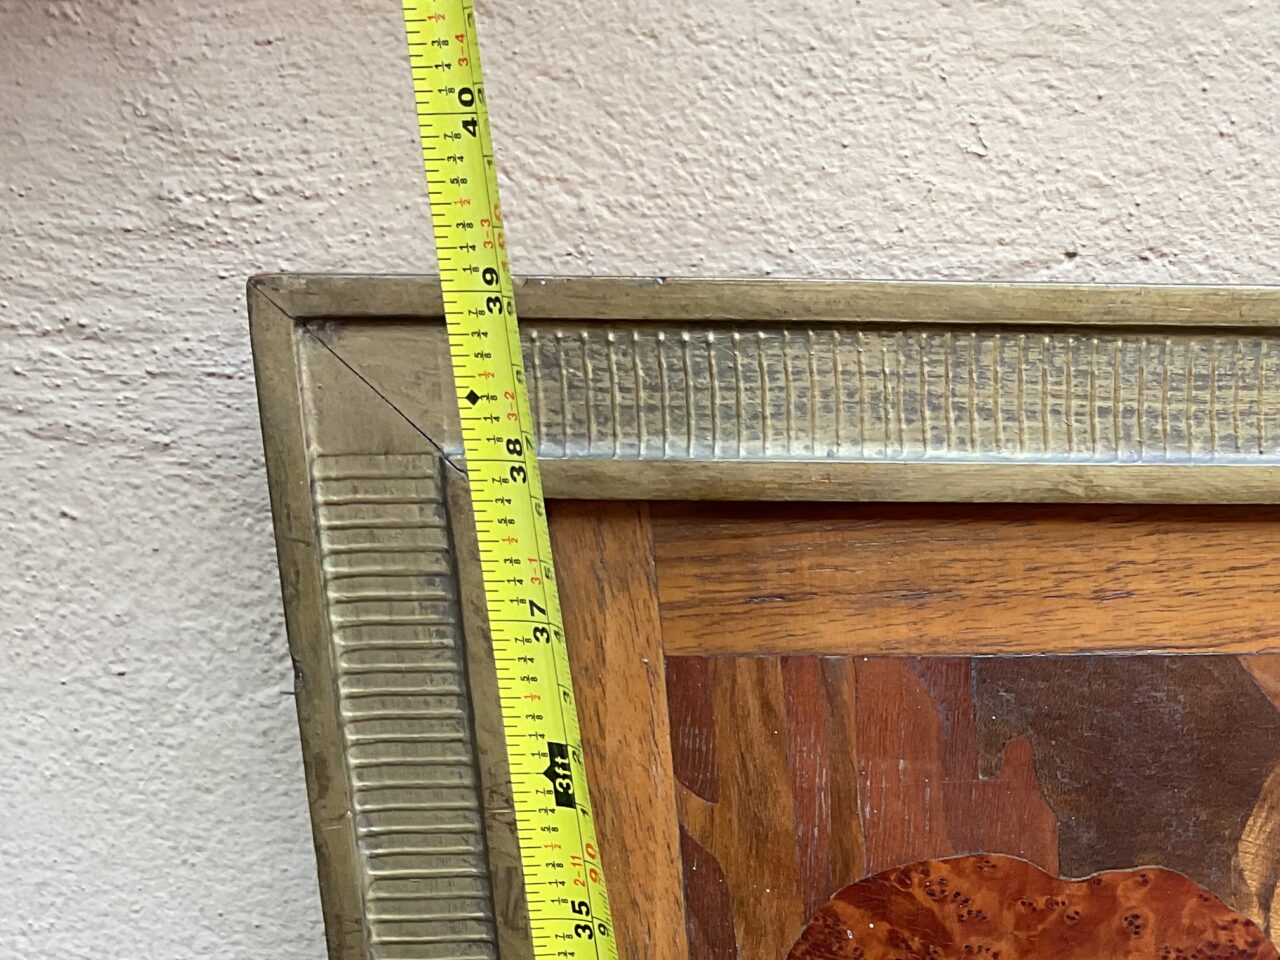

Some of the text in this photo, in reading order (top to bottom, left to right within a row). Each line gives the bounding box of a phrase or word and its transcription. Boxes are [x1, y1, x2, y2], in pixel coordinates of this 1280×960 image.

[458, 87, 478, 137] 40
[482, 268, 502, 314] 39
[506, 438, 526, 484] 38
[529, 600, 549, 644] 37
[571, 900, 593, 939] 35
[598, 923, 609, 937] 9
